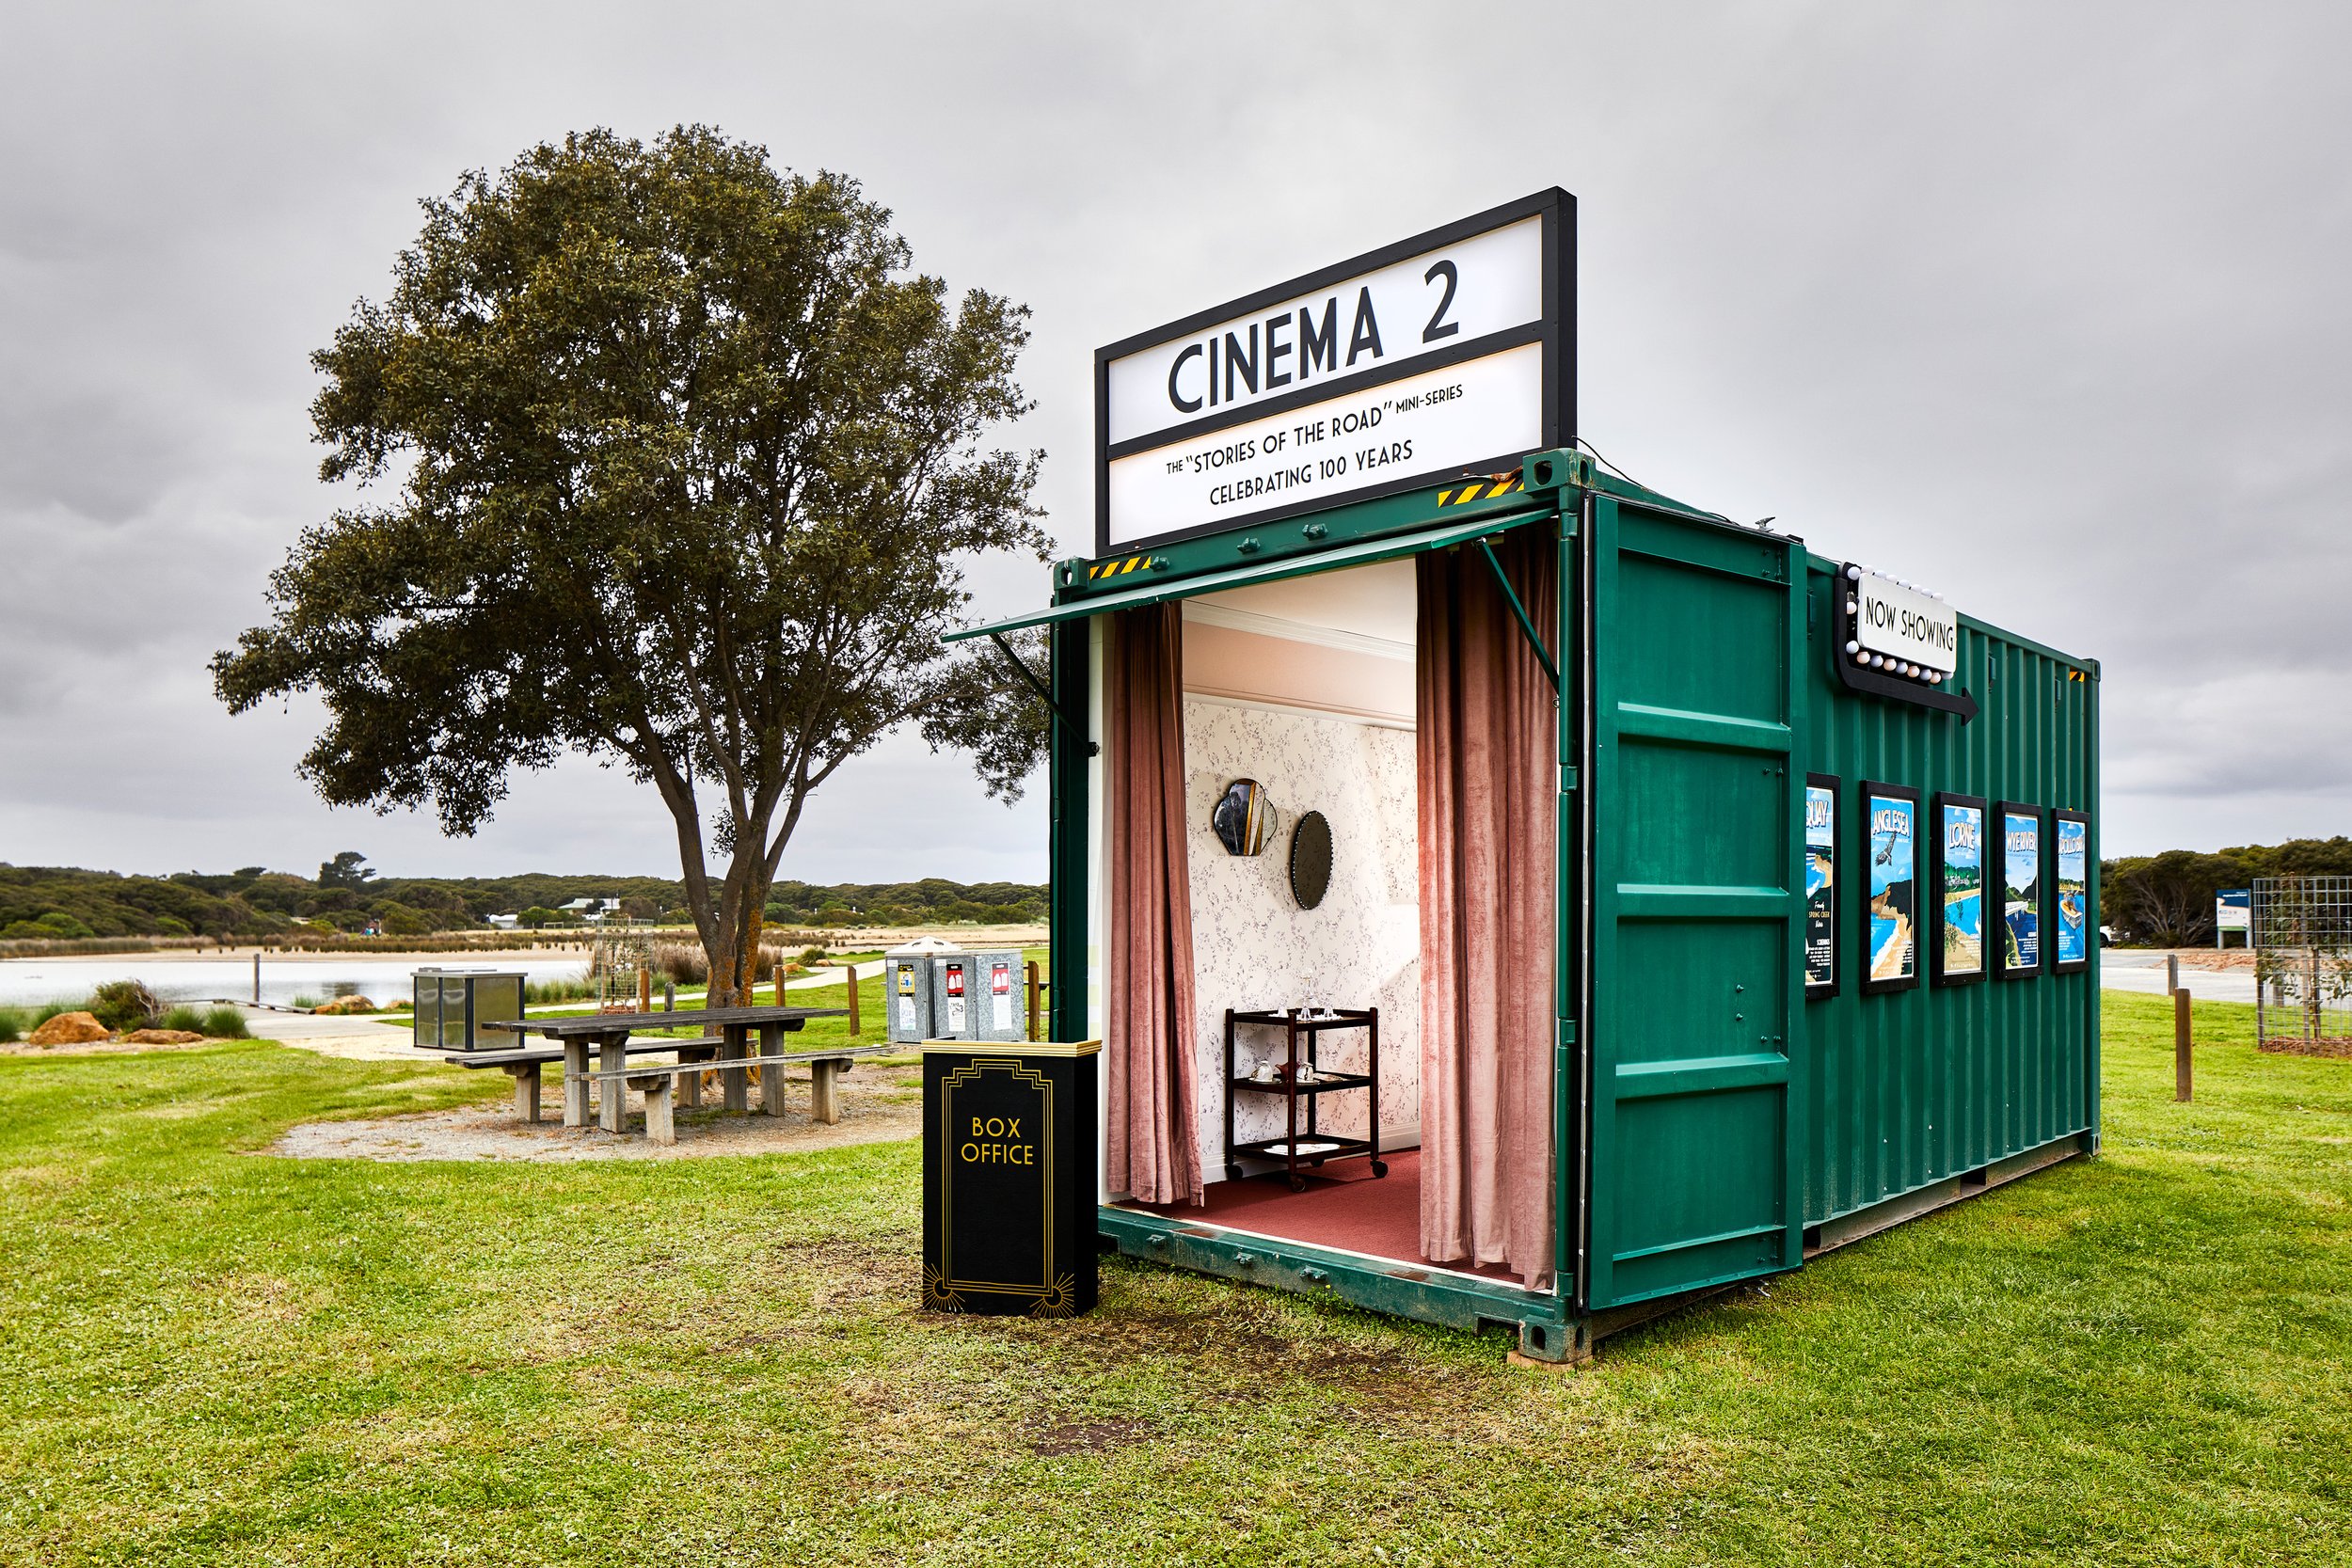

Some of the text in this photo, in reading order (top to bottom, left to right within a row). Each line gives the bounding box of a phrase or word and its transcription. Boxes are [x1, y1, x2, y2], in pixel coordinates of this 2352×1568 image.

[1168, 260, 1459, 414] CINEMA 2
[1166, 459, 1184, 475] THE
[1263, 431, 1287, 454] OF
[1295, 420, 1325, 447] THE
[1396, 384, 1463, 414] MINI-SERIES
[1210, 439, 1413, 506] CELEBRATING 100 YEARS
[1866, 595, 1953, 652] NOW SHOWING
[1872, 809, 1911, 837] ANGLESEA
[1948, 822, 1976, 850] LORNE
[2006, 831, 2037, 852] WYE RIVER
[972, 1117, 1021, 1138] BOX
[961, 1142, 1034, 1165] OFFICE
